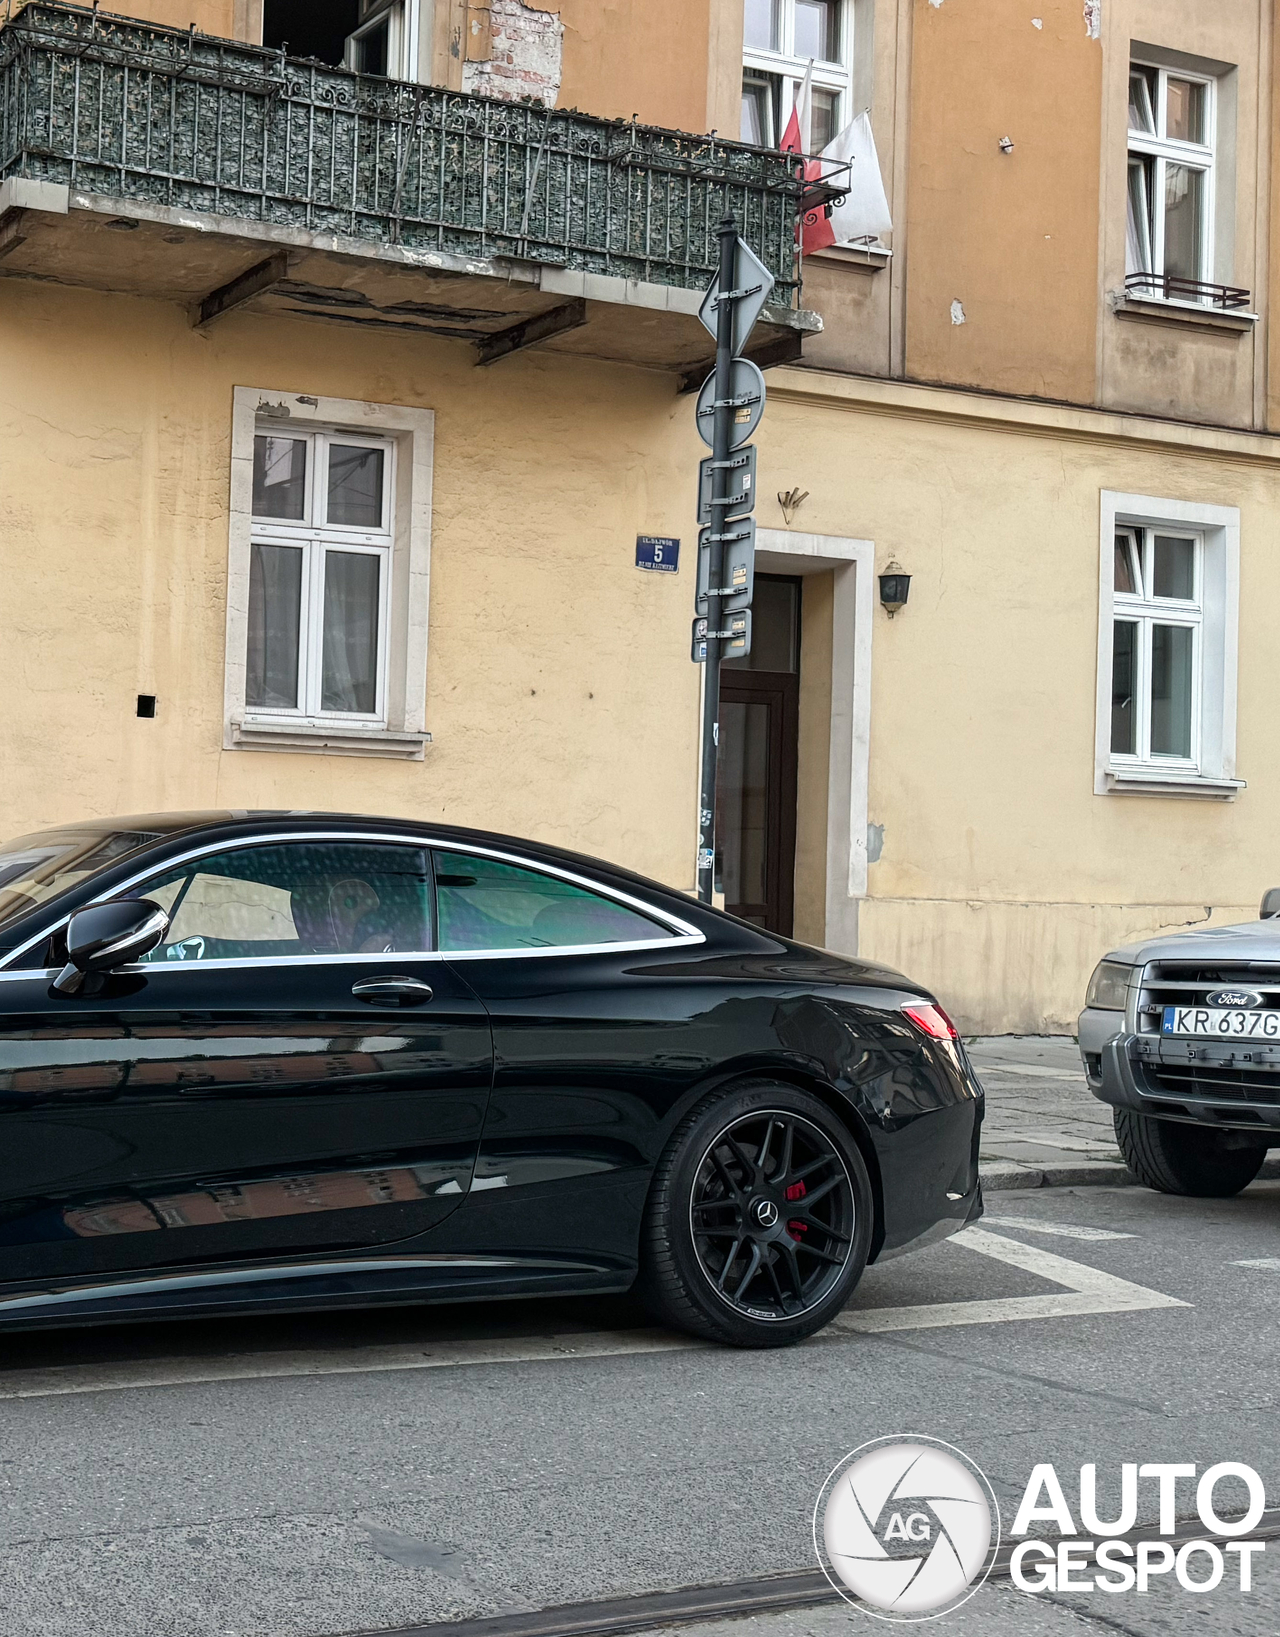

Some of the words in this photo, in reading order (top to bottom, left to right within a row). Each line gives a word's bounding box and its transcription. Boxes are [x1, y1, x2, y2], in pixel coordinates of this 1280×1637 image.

[654, 545, 663, 562] 5
[1218, 993, 1248, 1006] Ford
[1177, 1010, 1209, 1032] KR
[1218, 1011, 1280, 1036] 637G
